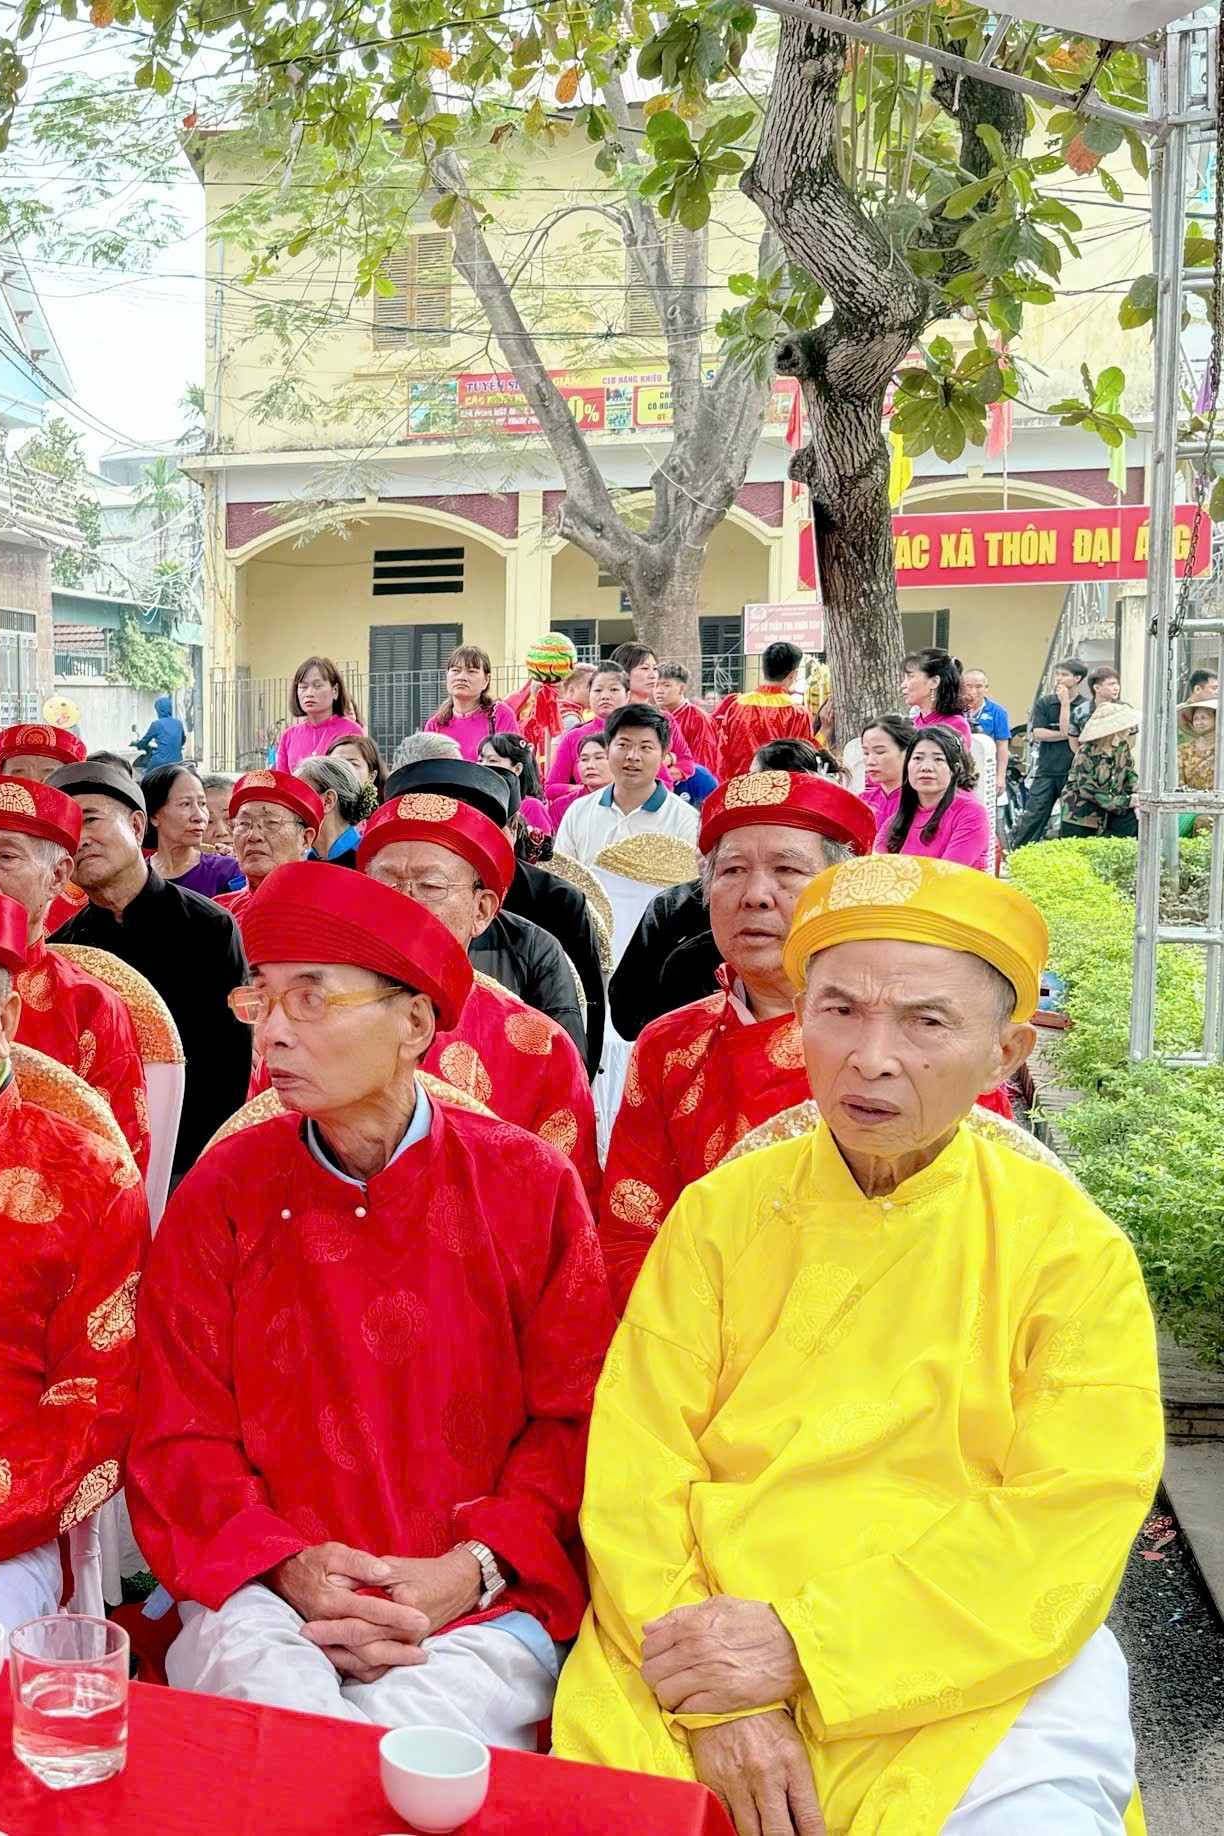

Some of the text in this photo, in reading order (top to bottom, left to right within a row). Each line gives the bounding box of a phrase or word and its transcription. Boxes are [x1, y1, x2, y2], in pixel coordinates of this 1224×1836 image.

[893, 519, 1192, 570] ÁC XÃ THÔN ĐẠI ÁG
